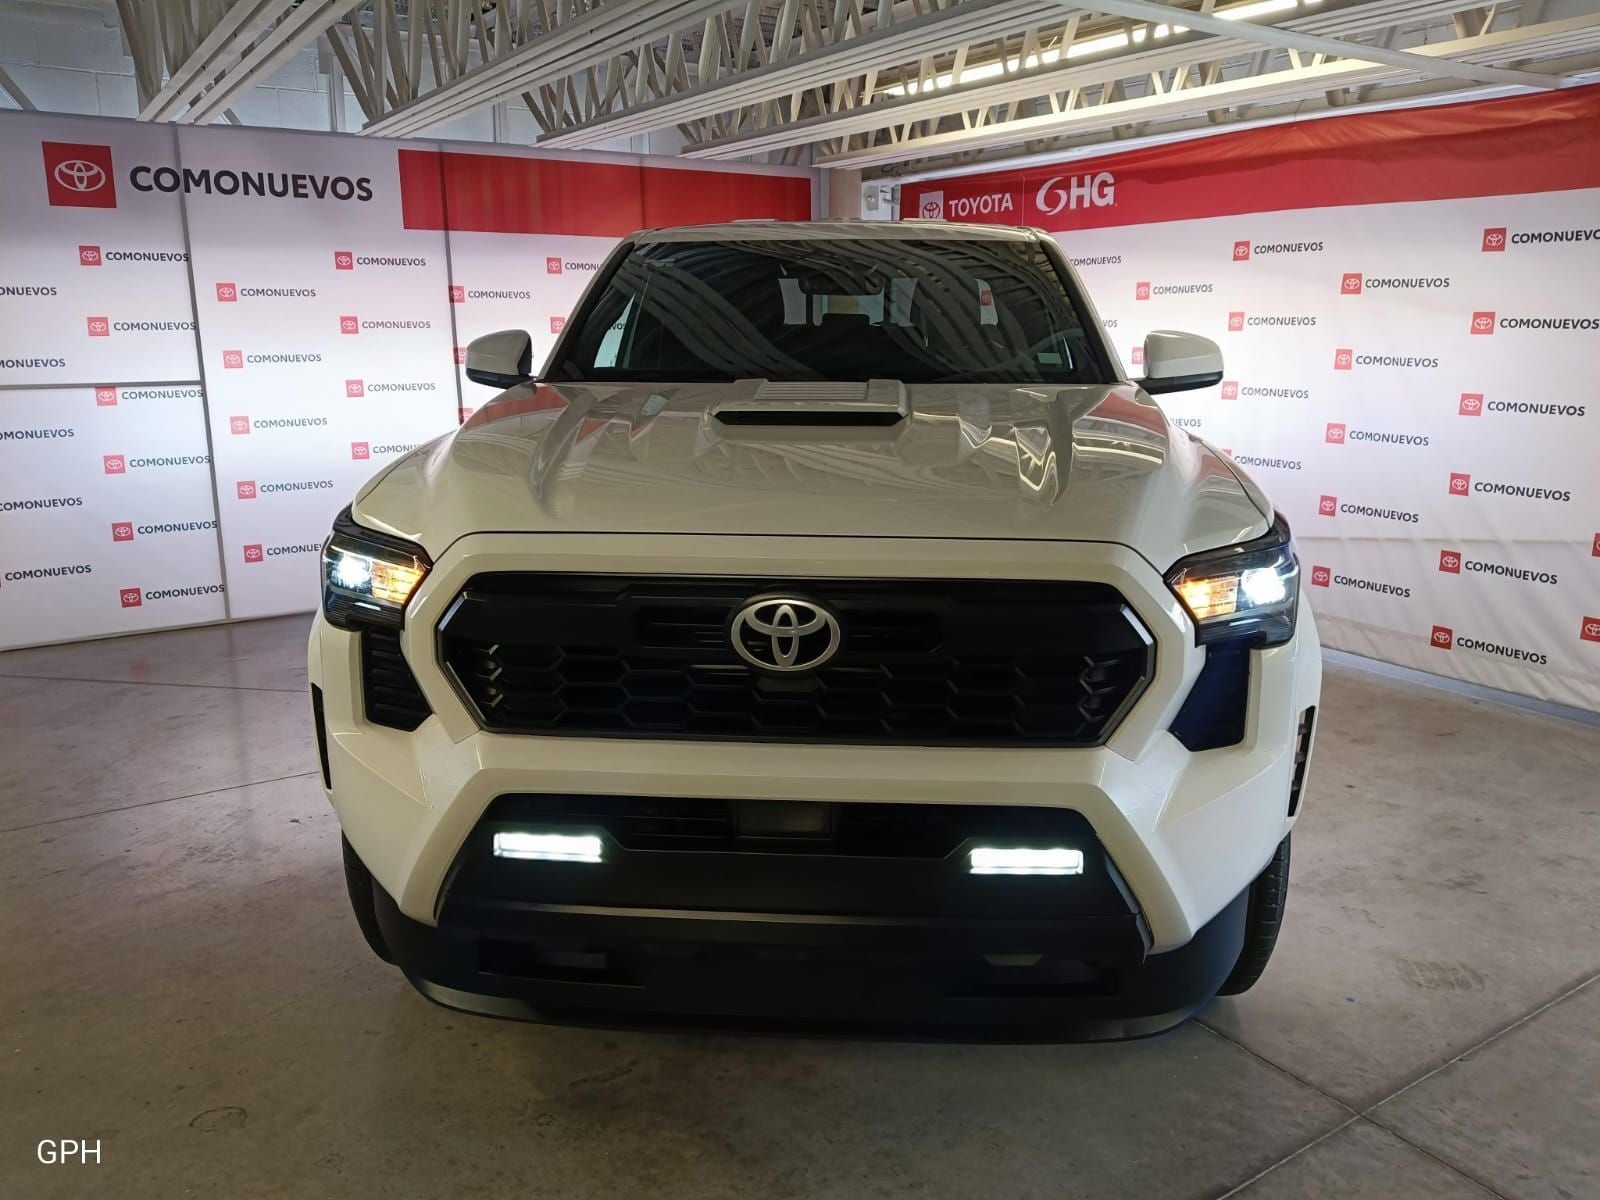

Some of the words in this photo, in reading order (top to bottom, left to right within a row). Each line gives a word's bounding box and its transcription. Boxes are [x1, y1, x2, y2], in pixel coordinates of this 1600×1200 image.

[129, 164, 374, 203] COMONUEVOS
[948, 192, 1014, 218] TOYOTA
[1253, 241, 1324, 255] COMONUEVOS
[105, 251, 189, 262] COMONUEVOS
[356, 256, 427, 267] COMONUEVOS
[1152, 283, 1213, 295] COMONUEVOS
[1365, 277, 1450, 289] COMONUEVOS
[240, 288, 317, 298] COMONUEVOS
[467, 290, 531, 300] COMONUEVOS
[113, 321, 196, 332] COMONUEVOS
[361, 320, 431, 329] COMONUEVOS
[1247, 316, 1317, 327] COMONUEVOS
[1499, 318, 1600, 330] COMONUEVOS
[246, 353, 322, 364] COMONUEVOS
[1355, 355, 1439, 368] COMONUEVOS
[367, 382, 436, 391] COMONUEVOS
[1241, 386, 1309, 399] COMONUEVOS
[121, 389, 203, 400] COMONUEVOS
[1487, 401, 1586, 417] COMONUEVOS
[253, 417, 328, 429] COMONUEVOS
[1349, 430, 1429, 447] COMONUEVOS
[129, 455, 211, 468] COMONUEVOS
[259, 479, 334, 493] COMONUEVOS
[1474, 481, 1571, 502] COMONUEVOS
[1340, 503, 1419, 524] COMONUEVOS
[137, 520, 217, 534] COMONUEVOS
[4, 564, 92, 581] COMONUEVOS
[1464, 560, 1558, 585] COMONUEVOS
[145, 584, 225, 600] COMONUEVOS
[1333, 575, 1411, 598] COMONUEVOS
[1456, 636, 1547, 665] COMONUEVOS
